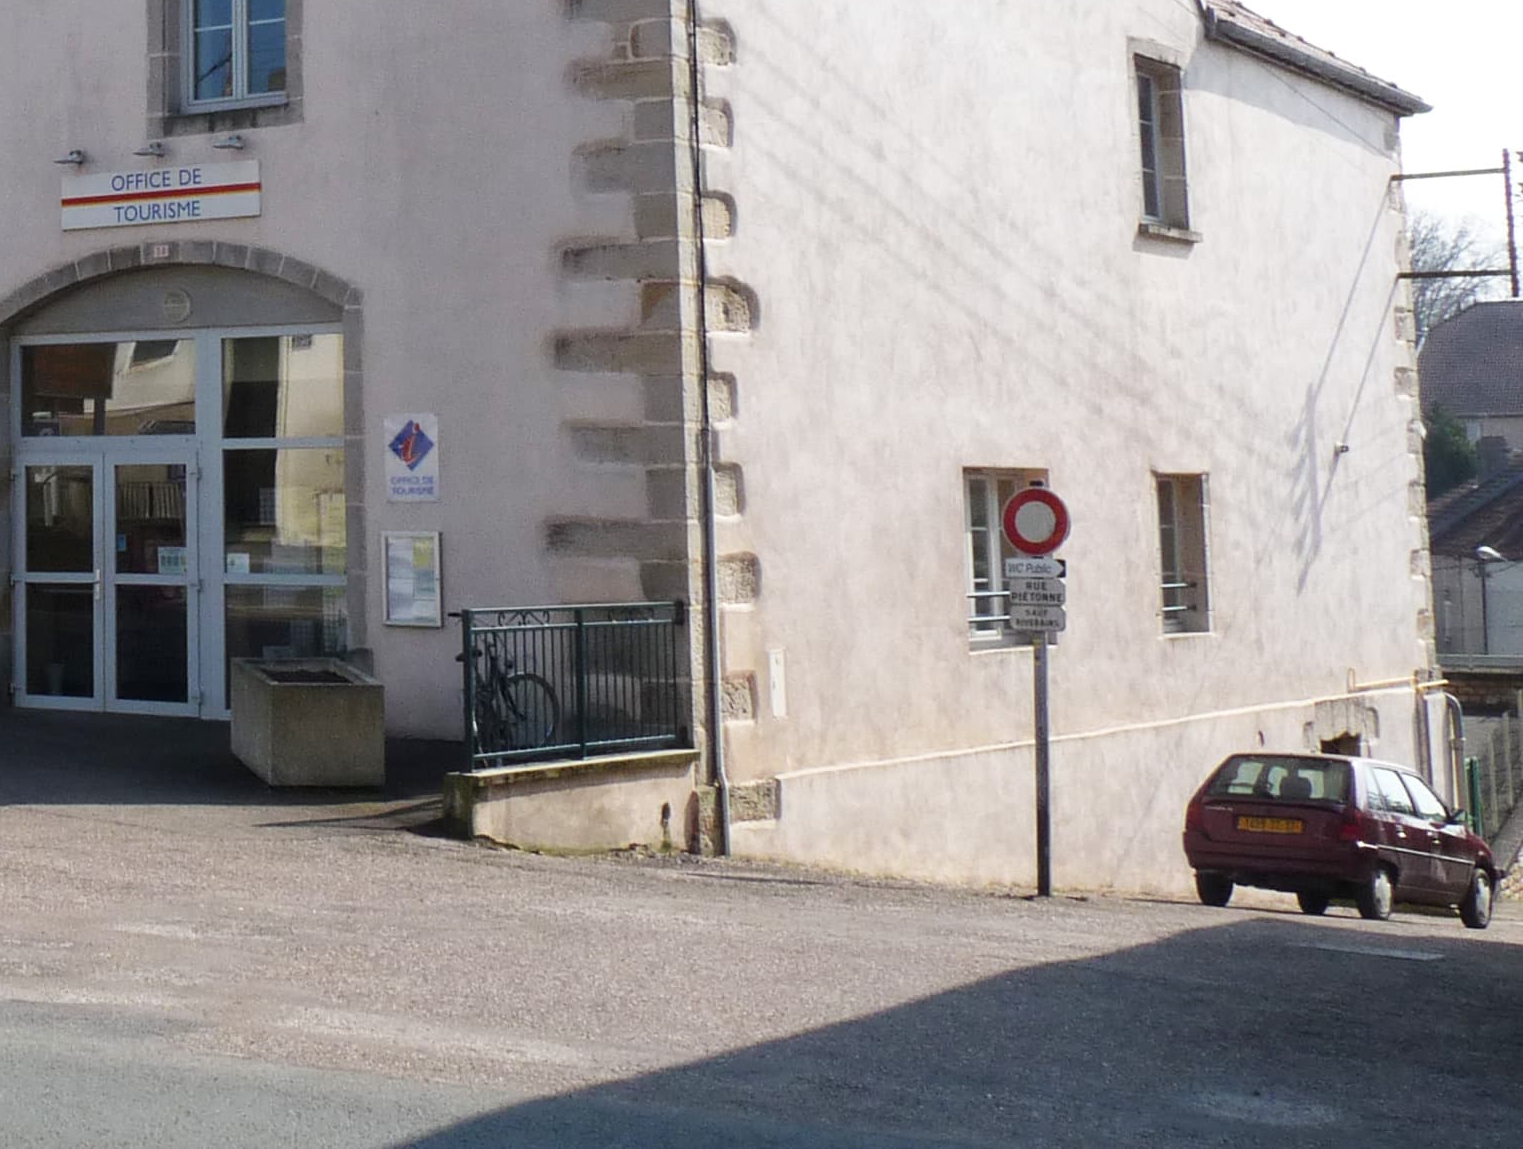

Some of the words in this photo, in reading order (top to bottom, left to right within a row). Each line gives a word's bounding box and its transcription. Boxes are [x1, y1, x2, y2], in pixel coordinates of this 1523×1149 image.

[111, 170, 172, 192] OFFICE
[178, 168, 202, 186] DE
[113, 200, 201, 223] TOURISME
[1008, 563, 1024, 574] WC
[1026, 562, 1053, 574] Public
[1025, 581, 1047, 591] RUE
